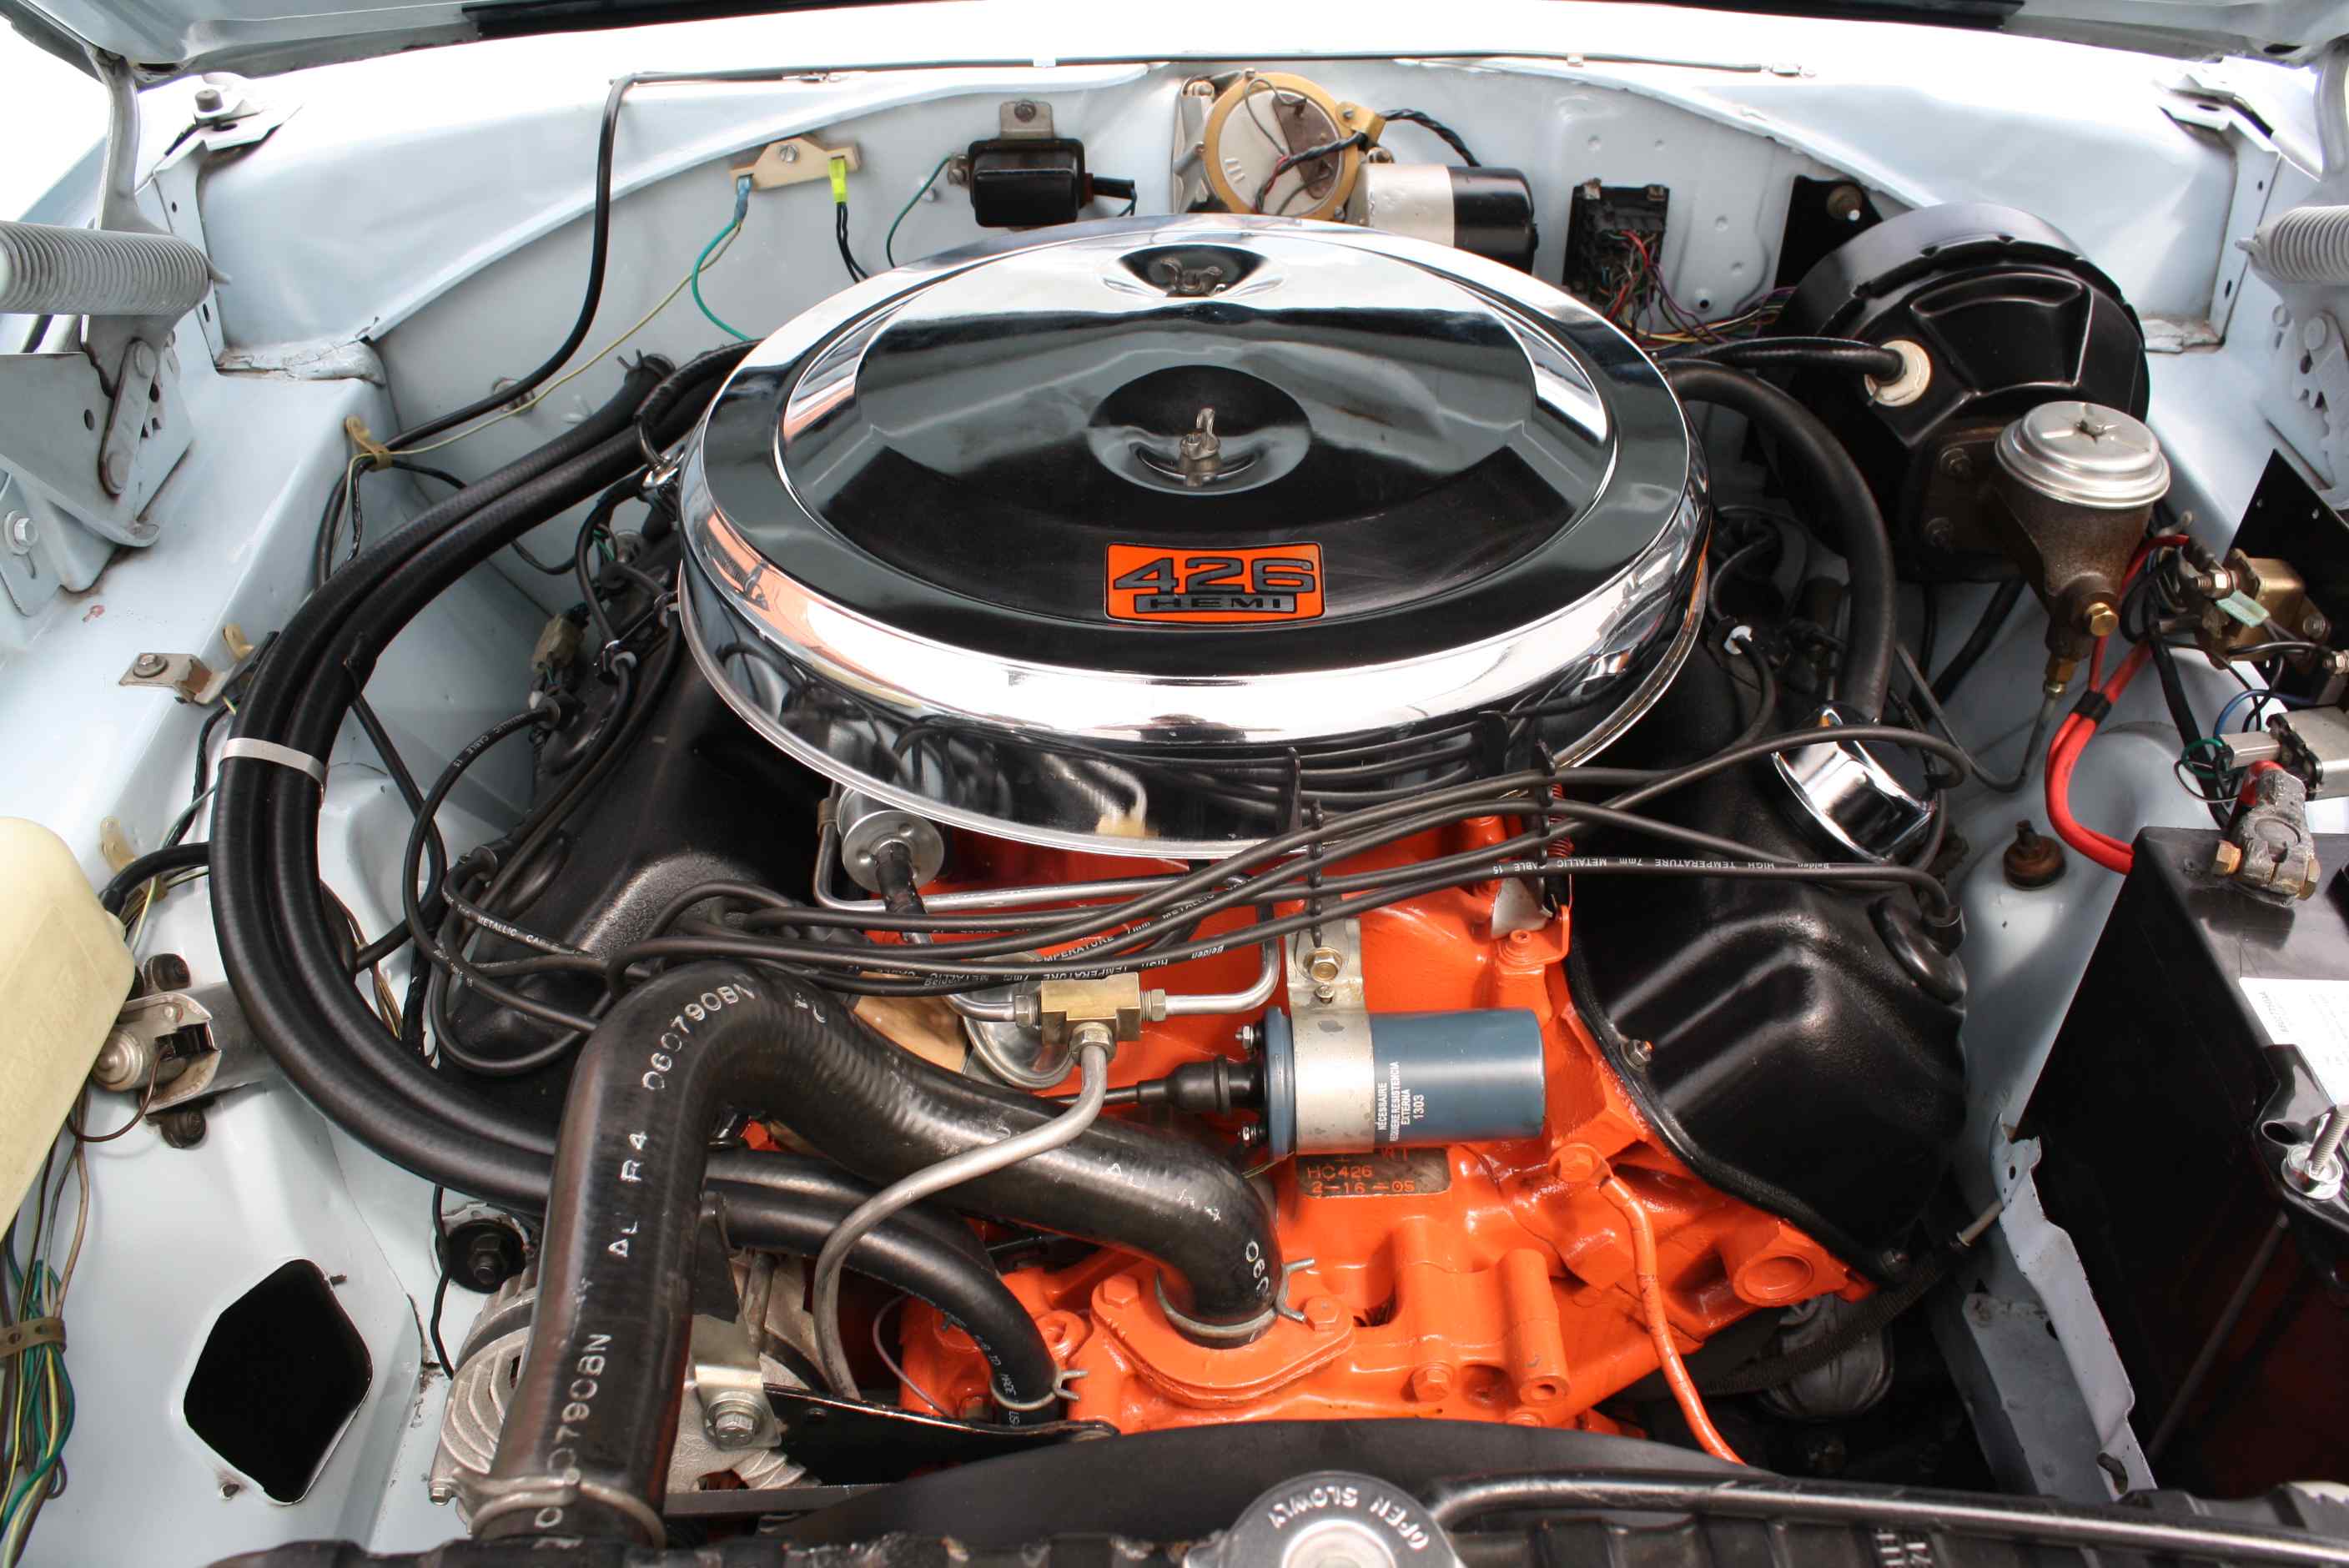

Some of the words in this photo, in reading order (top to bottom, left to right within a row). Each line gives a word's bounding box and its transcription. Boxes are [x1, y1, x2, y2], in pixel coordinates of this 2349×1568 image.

[1113, 556, 1316, 595] 426
[1149, 596, 1282, 610] HEMI
[1557, 857, 1607, 868] METALLIC
[1654, 857, 1737, 869] TEMPERATURE
[1748, 861, 1775, 869] HIGH
[477, 915, 518, 937] METALLIC
[1389, 1060, 1401, 1113] RESISTENCIA
[1401, 1088, 1411, 1125] EXTERNA
[1412, 1093, 1425, 1119] 1303
[1306, 1164, 1374, 1179] HC426
[1267, 1485, 1358, 1529] SLOWLY
[1369, 1496, 1429, 1550] OPEN
